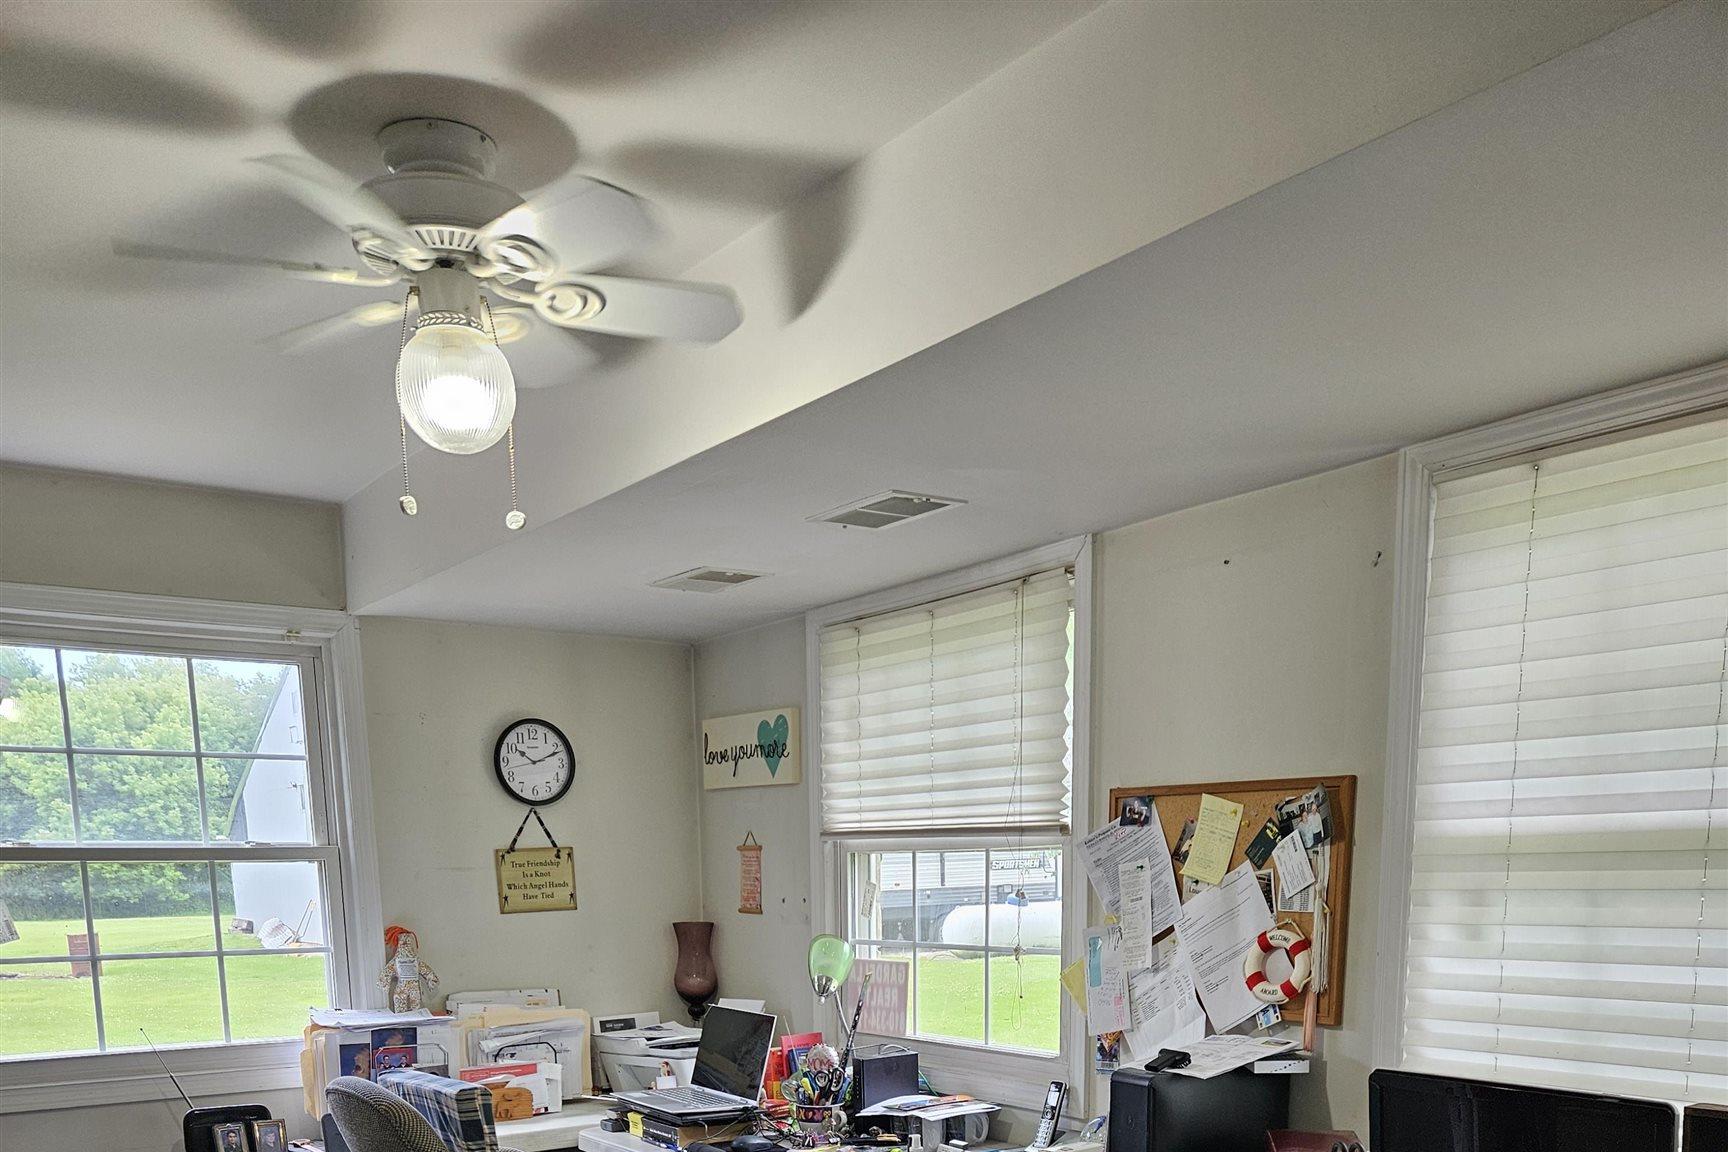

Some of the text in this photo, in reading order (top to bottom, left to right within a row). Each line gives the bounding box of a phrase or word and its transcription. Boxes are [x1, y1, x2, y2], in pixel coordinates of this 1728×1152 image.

[516, 732, 525, 744] 11
[528, 728, 538, 740] 12
[544, 732, 548, 744] 1
[506, 742, 518, 755] 10
[552, 742, 559, 754] 2
[704, 732, 730, 765] love
[730, 744, 754, 778] you
[502, 756, 510, 768] 9
[558, 758, 565, 769] 3
[508, 770, 514, 782] 8
[553, 772, 560, 783] 4
[518, 782, 525, 793] 7
[532, 784, 538, 796] 6
[545, 781, 552, 793] 5
[526, 860, 560, 868] Friendship
[991, 859, 1039, 870] SPORTSMEN
